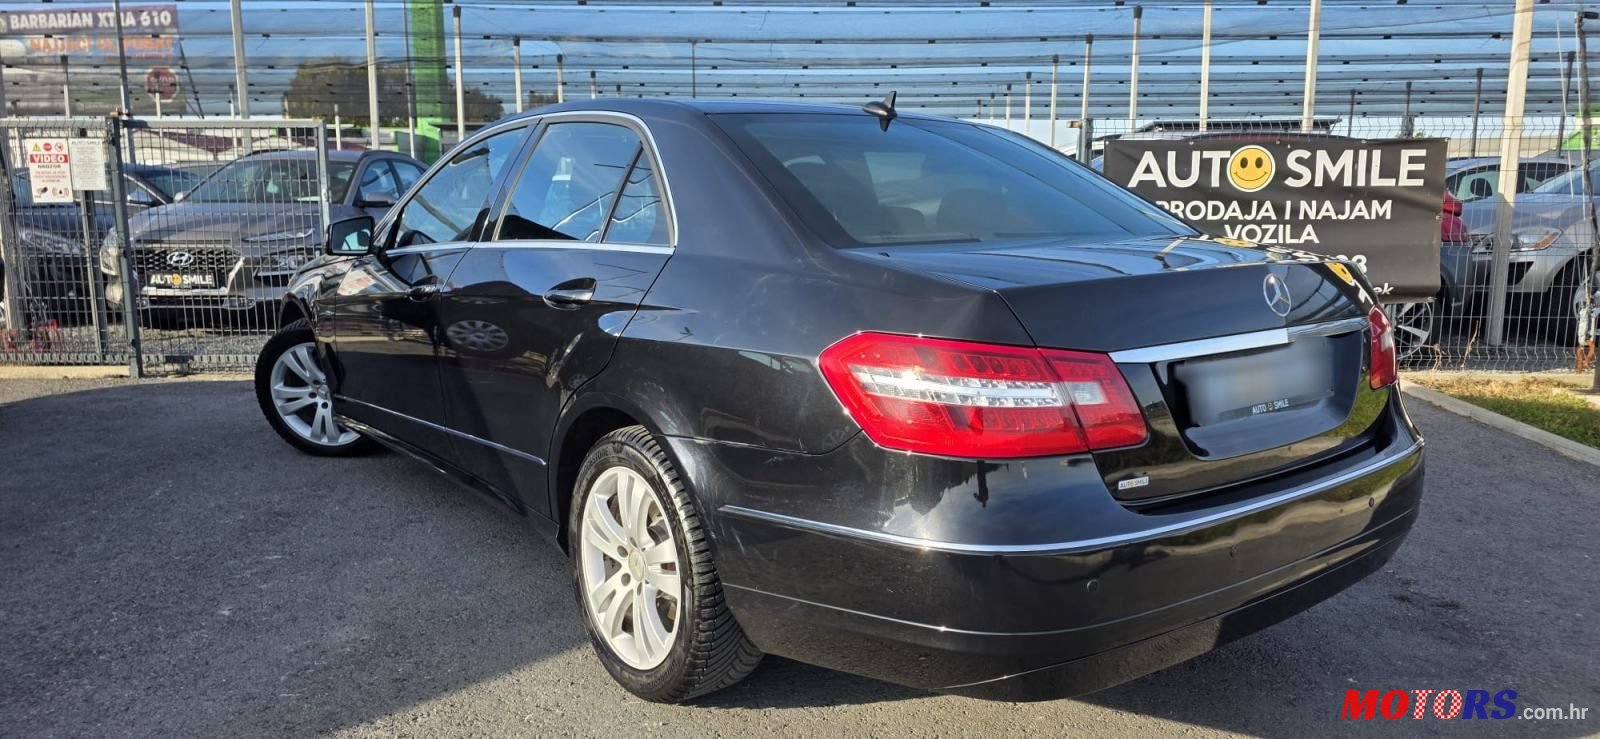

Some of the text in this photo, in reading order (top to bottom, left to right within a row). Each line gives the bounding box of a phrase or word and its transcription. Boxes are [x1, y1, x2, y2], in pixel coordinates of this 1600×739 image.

[10, 12, 94, 30] BARBARIAN
[140, 10, 172, 26] 610
[33, 155, 65, 163] VIDEO
[1284, 149, 1427, 188] SMILE
[1284, 201, 1292, 220] I
[1298, 199, 1392, 220] NAJAM
[1224, 224, 1319, 244] VOZILA
[182, 273, 213, 285] SMILE
[1252, 399, 1289, 415] AUTO SMILE
